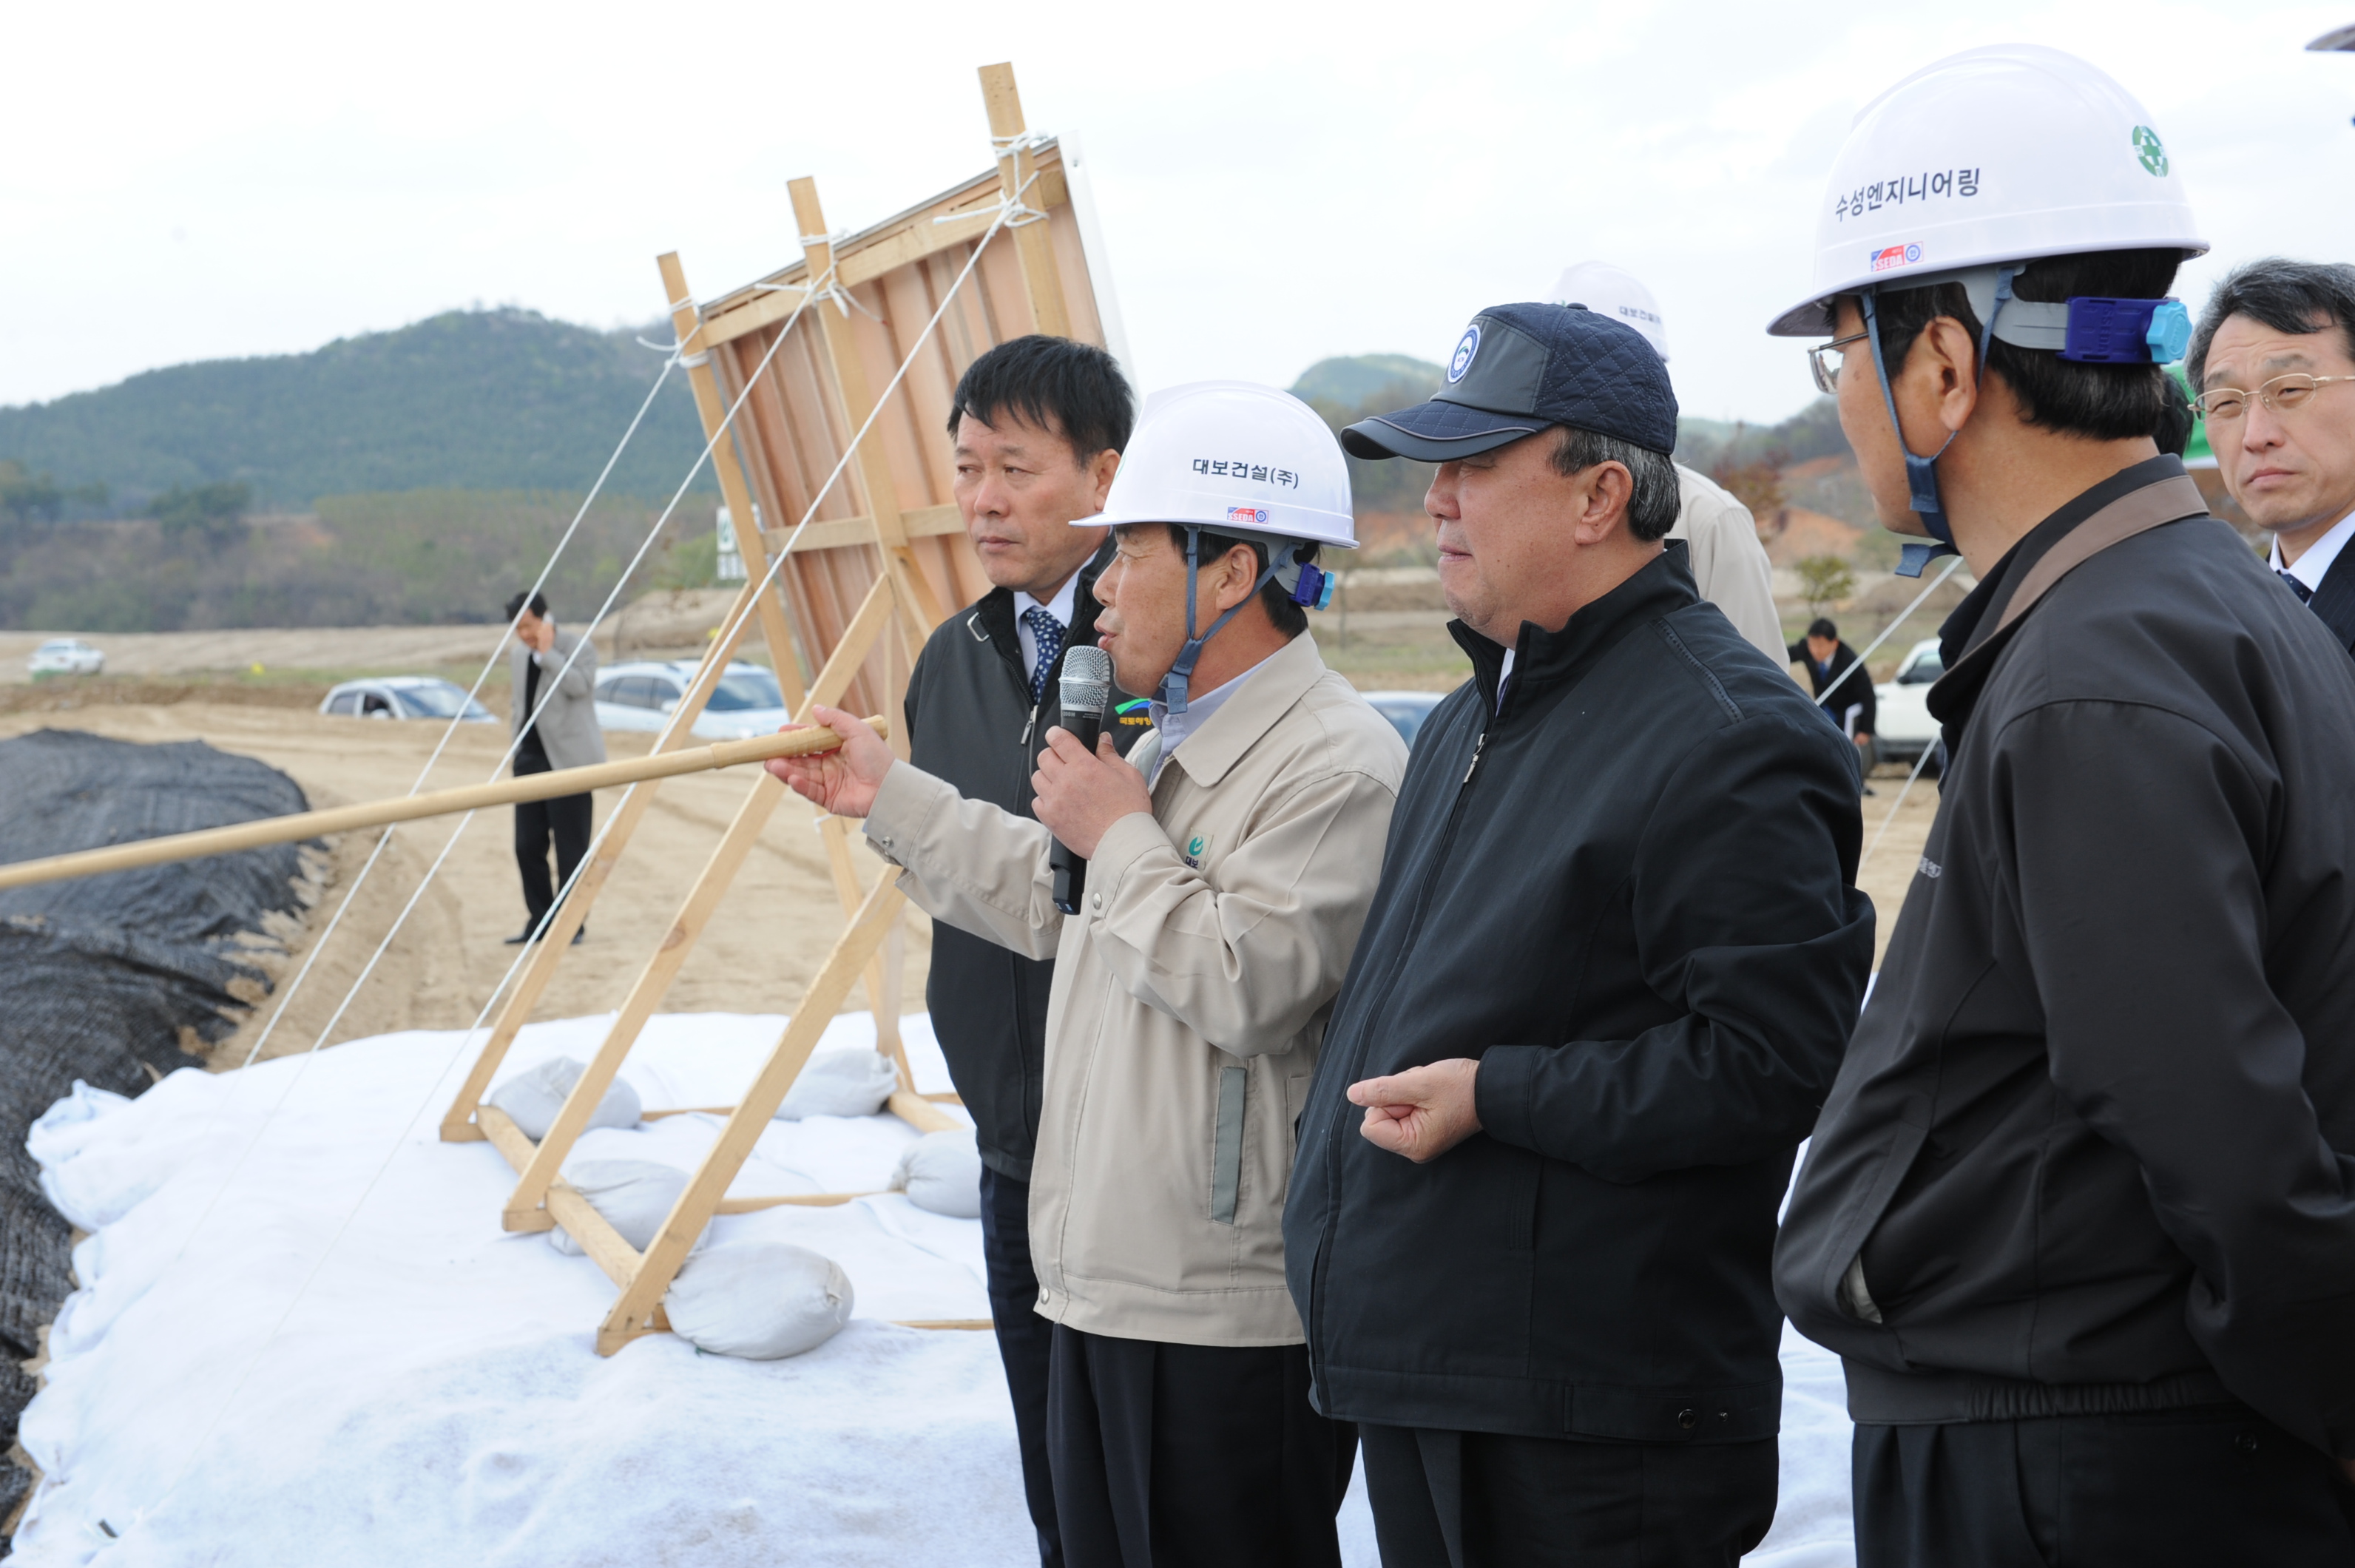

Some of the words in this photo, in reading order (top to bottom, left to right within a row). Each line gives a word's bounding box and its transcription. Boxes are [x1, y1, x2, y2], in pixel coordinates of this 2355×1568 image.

[1835, 168, 1981, 222] 수성엔지니어링
[1871, 254, 1903, 271] SSEDA
[1192, 458, 1300, 490] 대보건설(주)
[1228, 513, 1253, 522] SSEDA
[1185, 855, 1199, 869] 대보
